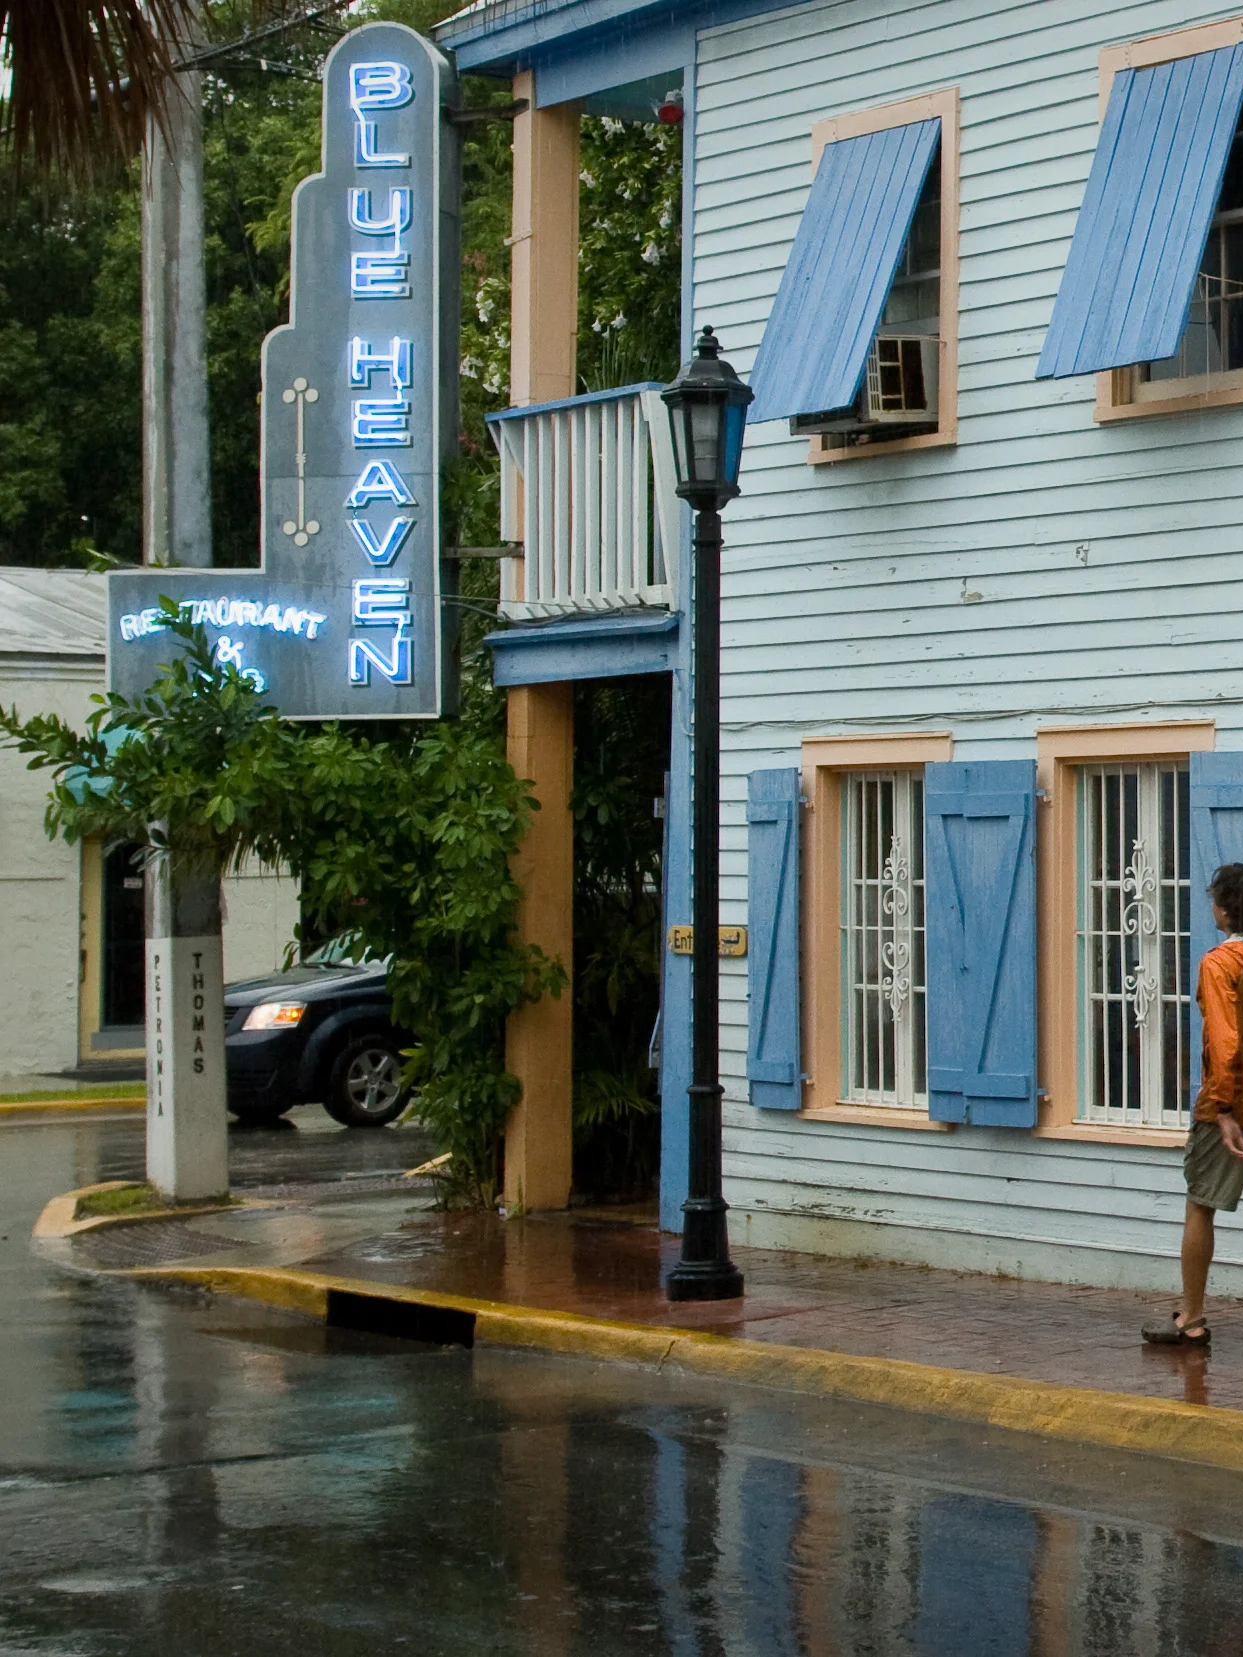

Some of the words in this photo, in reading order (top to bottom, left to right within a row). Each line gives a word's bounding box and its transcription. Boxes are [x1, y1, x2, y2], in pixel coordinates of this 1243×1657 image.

[348, 61, 413, 298] BLUE
[343, 335, 418, 686] HEAVEN
[217, 635, 245, 670] &
[673, 929, 693, 950] Ent
[154, 954, 163, 1117] PETRONIA
[193, 953, 204, 1074] THOMAS
